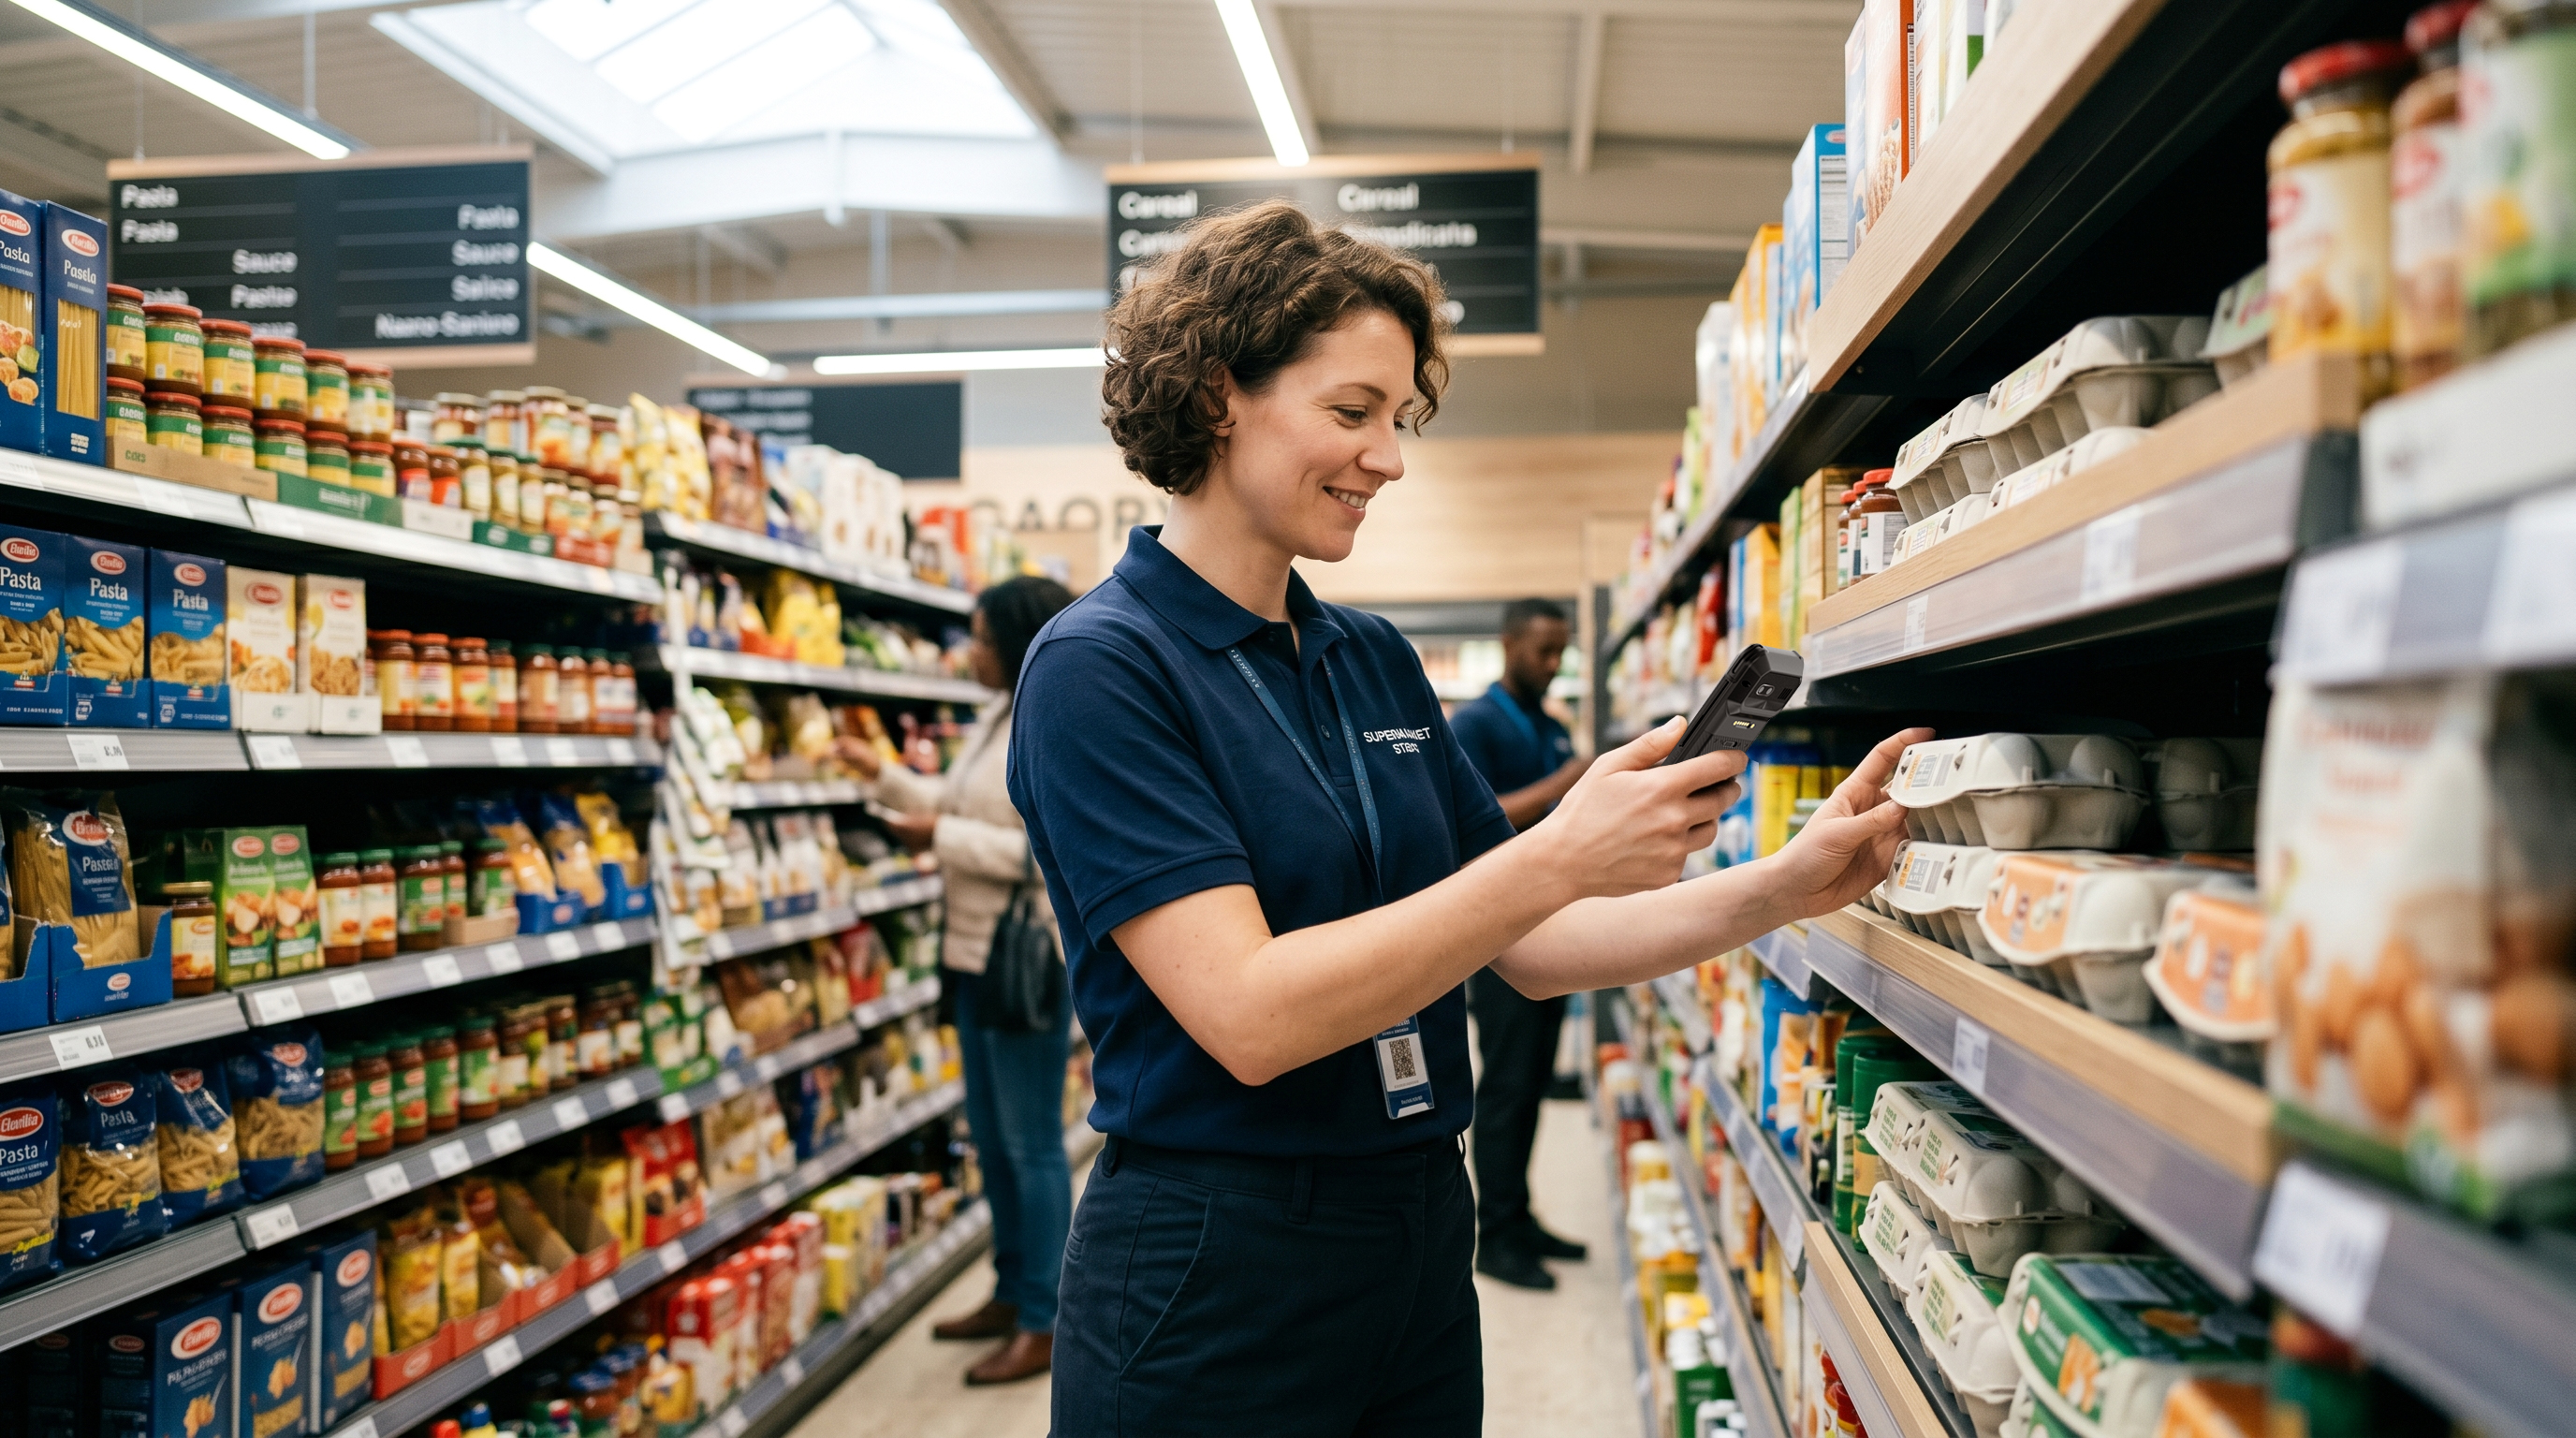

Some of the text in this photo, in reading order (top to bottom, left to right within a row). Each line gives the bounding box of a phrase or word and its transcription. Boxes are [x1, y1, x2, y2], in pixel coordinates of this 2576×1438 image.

[121, 183, 179, 209] Pasta
[1338, 182, 1419, 212] Cereal
[457, 204, 520, 230] Pasta
[121, 219, 179, 243] Pasta
[0, 566, 42, 592] Pasta
[90, 577, 128, 602] Pasta
[173, 588, 209, 612] Pasta
[0, 1144, 38, 1166] Pasta
